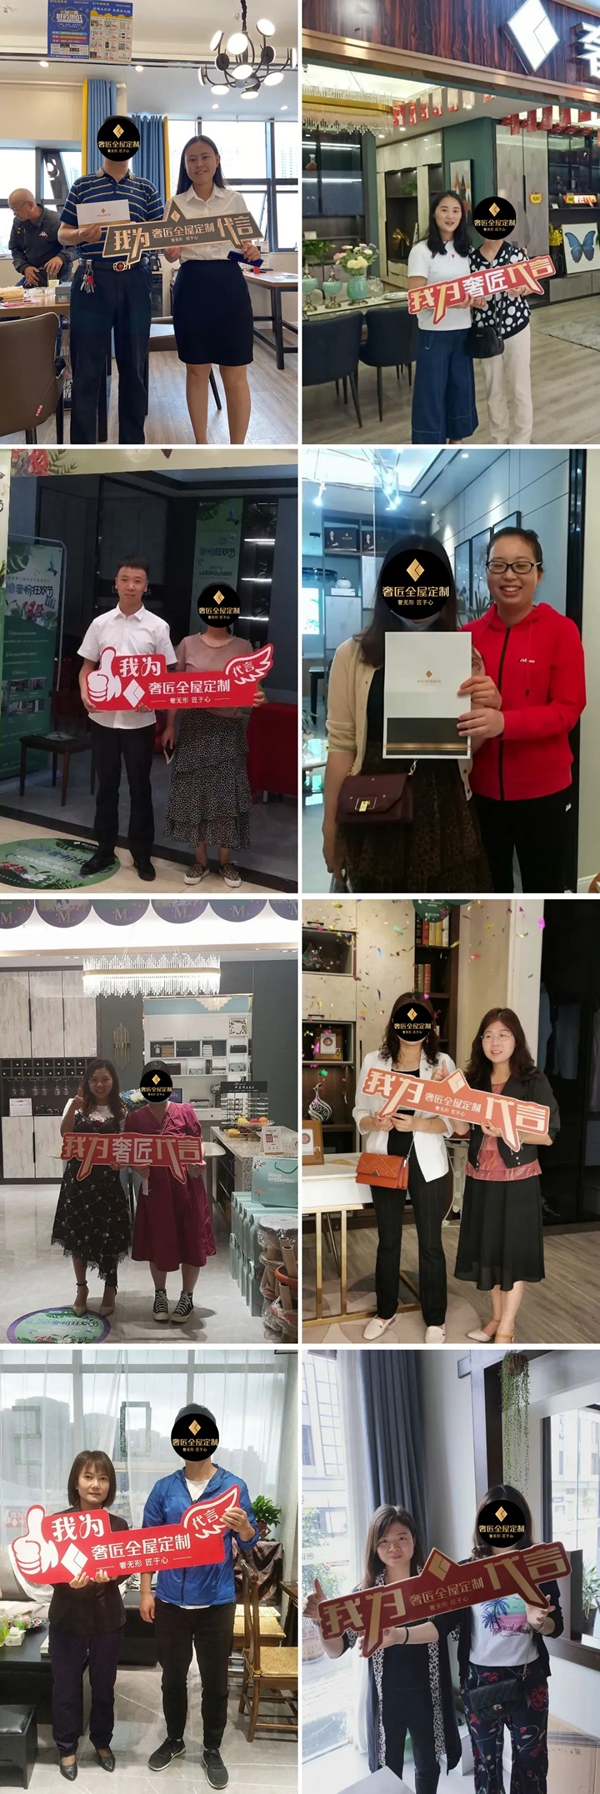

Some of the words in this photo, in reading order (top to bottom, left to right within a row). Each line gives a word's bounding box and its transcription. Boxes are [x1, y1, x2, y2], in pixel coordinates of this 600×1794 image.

[114, 227, 150, 259] 我为
[151, 222, 216, 239] 奢匠全屋定制
[217, 215, 254, 246] 代言
[119, 656, 161, 678] 我为
[233, 661, 255, 677] 代言
[148, 679, 231, 695] 奢匠全屋定制
[365, 1070, 424, 1116] 我为
[424, 1092, 482, 1113] 奢匠全屋定制
[485, 1096, 546, 1148] 代言
[65, 1135, 200, 1182] 我为奢匠代言
[51, 1514, 104, 1541] 我为
[192, 1508, 218, 1529] 代言
[91, 1533, 190, 1561] 奢匠全屋定制
[119, 1560, 142, 1570] 奢无形
[145, 1557, 168, 1566] 匠于心
[323, 1588, 406, 1653] 我为
[409, 1577, 485, 1607] 奢匠全屋定制
[485, 1548, 567, 1604] 代言
